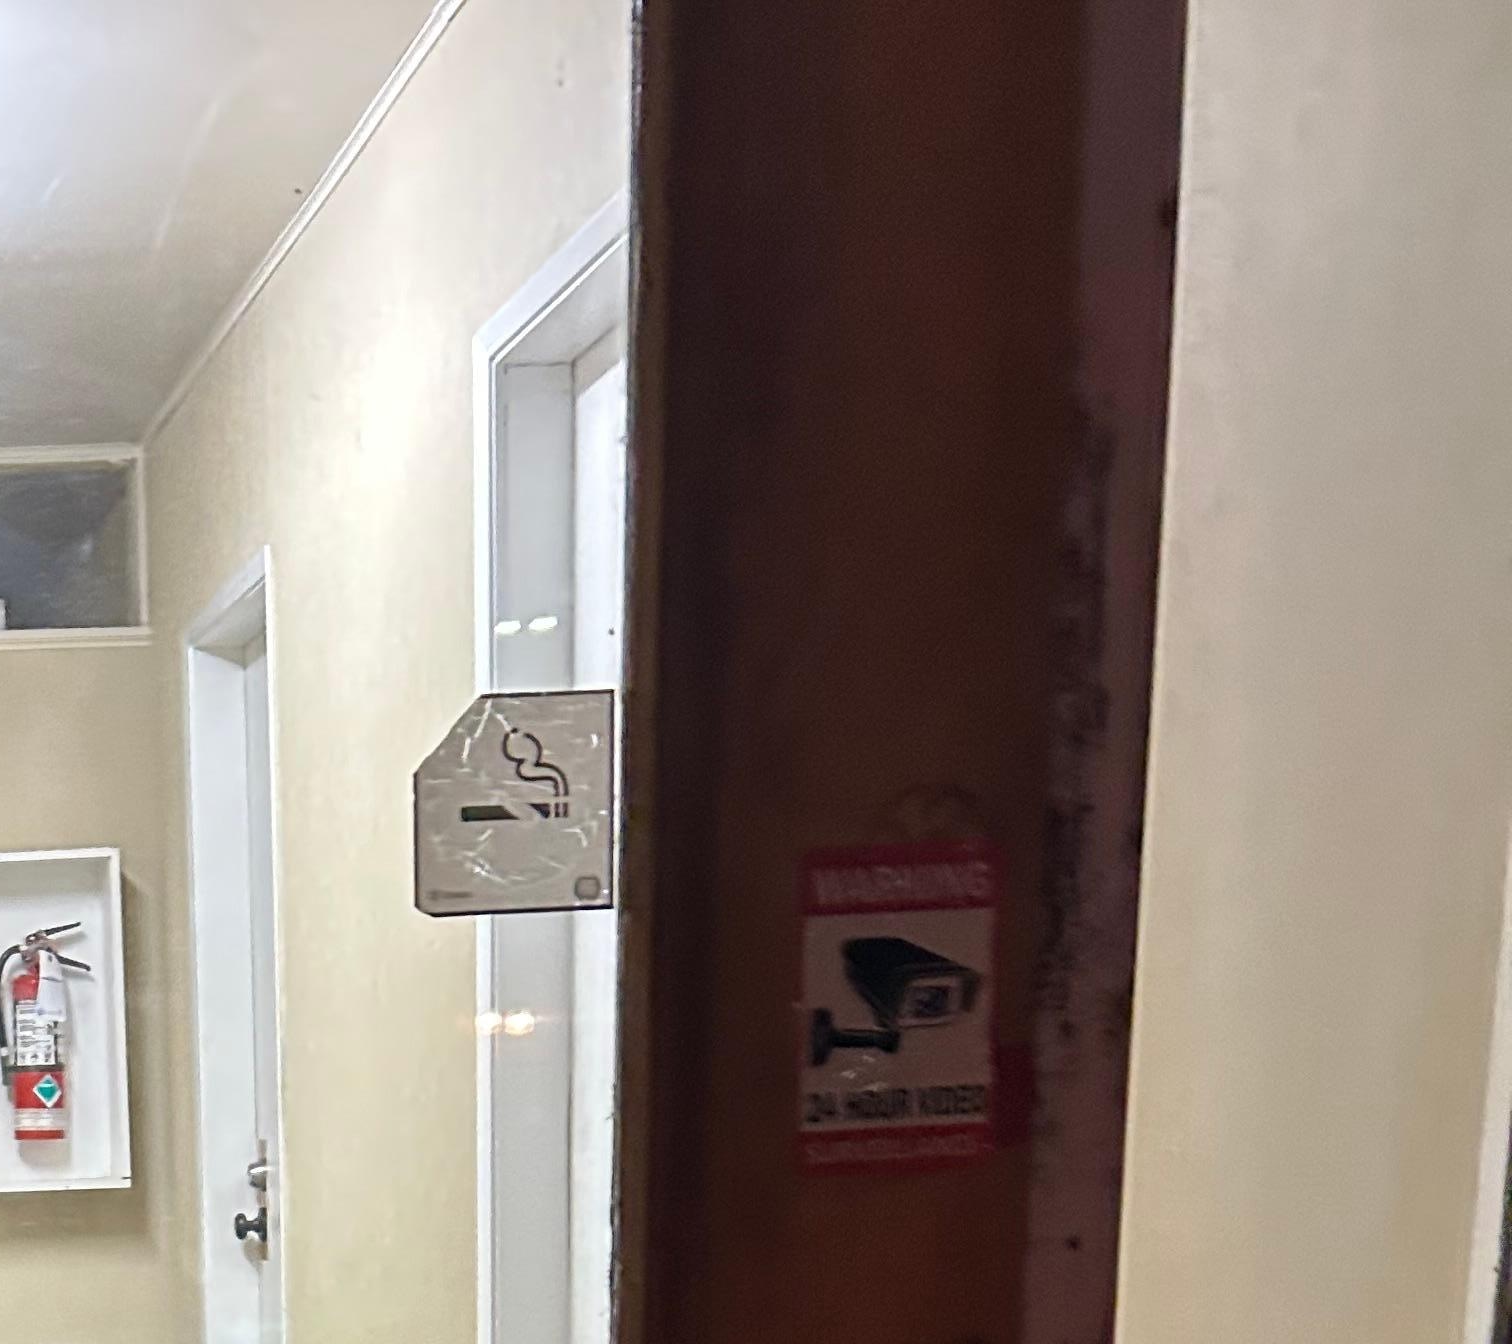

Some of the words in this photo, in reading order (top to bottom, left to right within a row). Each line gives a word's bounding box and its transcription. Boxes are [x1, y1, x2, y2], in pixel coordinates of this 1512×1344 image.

[811, 862, 989, 904] WARNING
[805, 1092, 837, 1122] 24
[843, 1089, 908, 1119] HOUR
[915, 1084, 987, 1114] VIDEO
